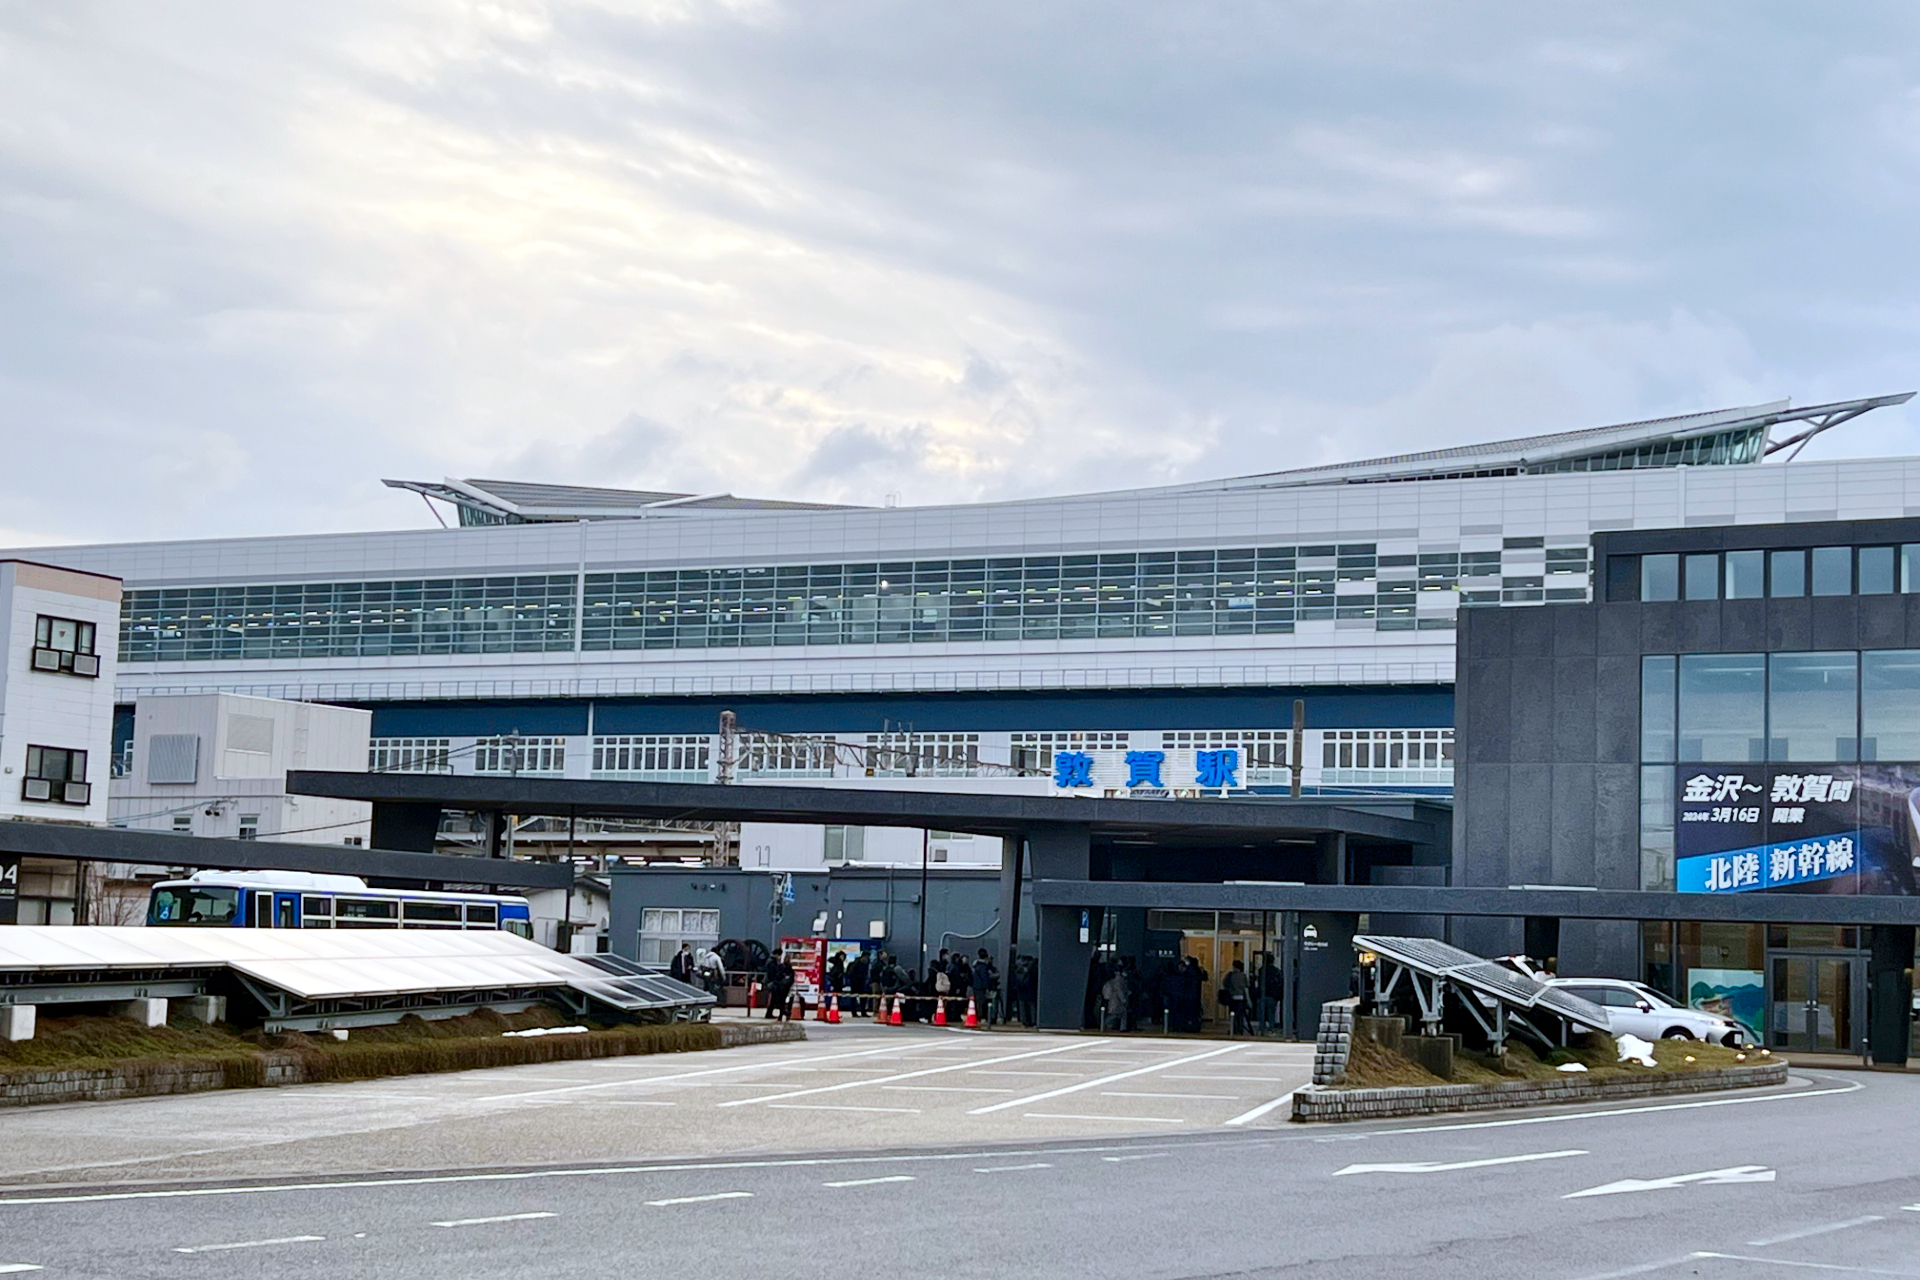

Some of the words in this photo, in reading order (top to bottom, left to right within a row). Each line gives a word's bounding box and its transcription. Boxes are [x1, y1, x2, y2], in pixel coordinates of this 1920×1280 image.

[1053, 750, 1239, 788] 敦賀駅
[1705, 837, 1854, 891] 北陸新幹線
